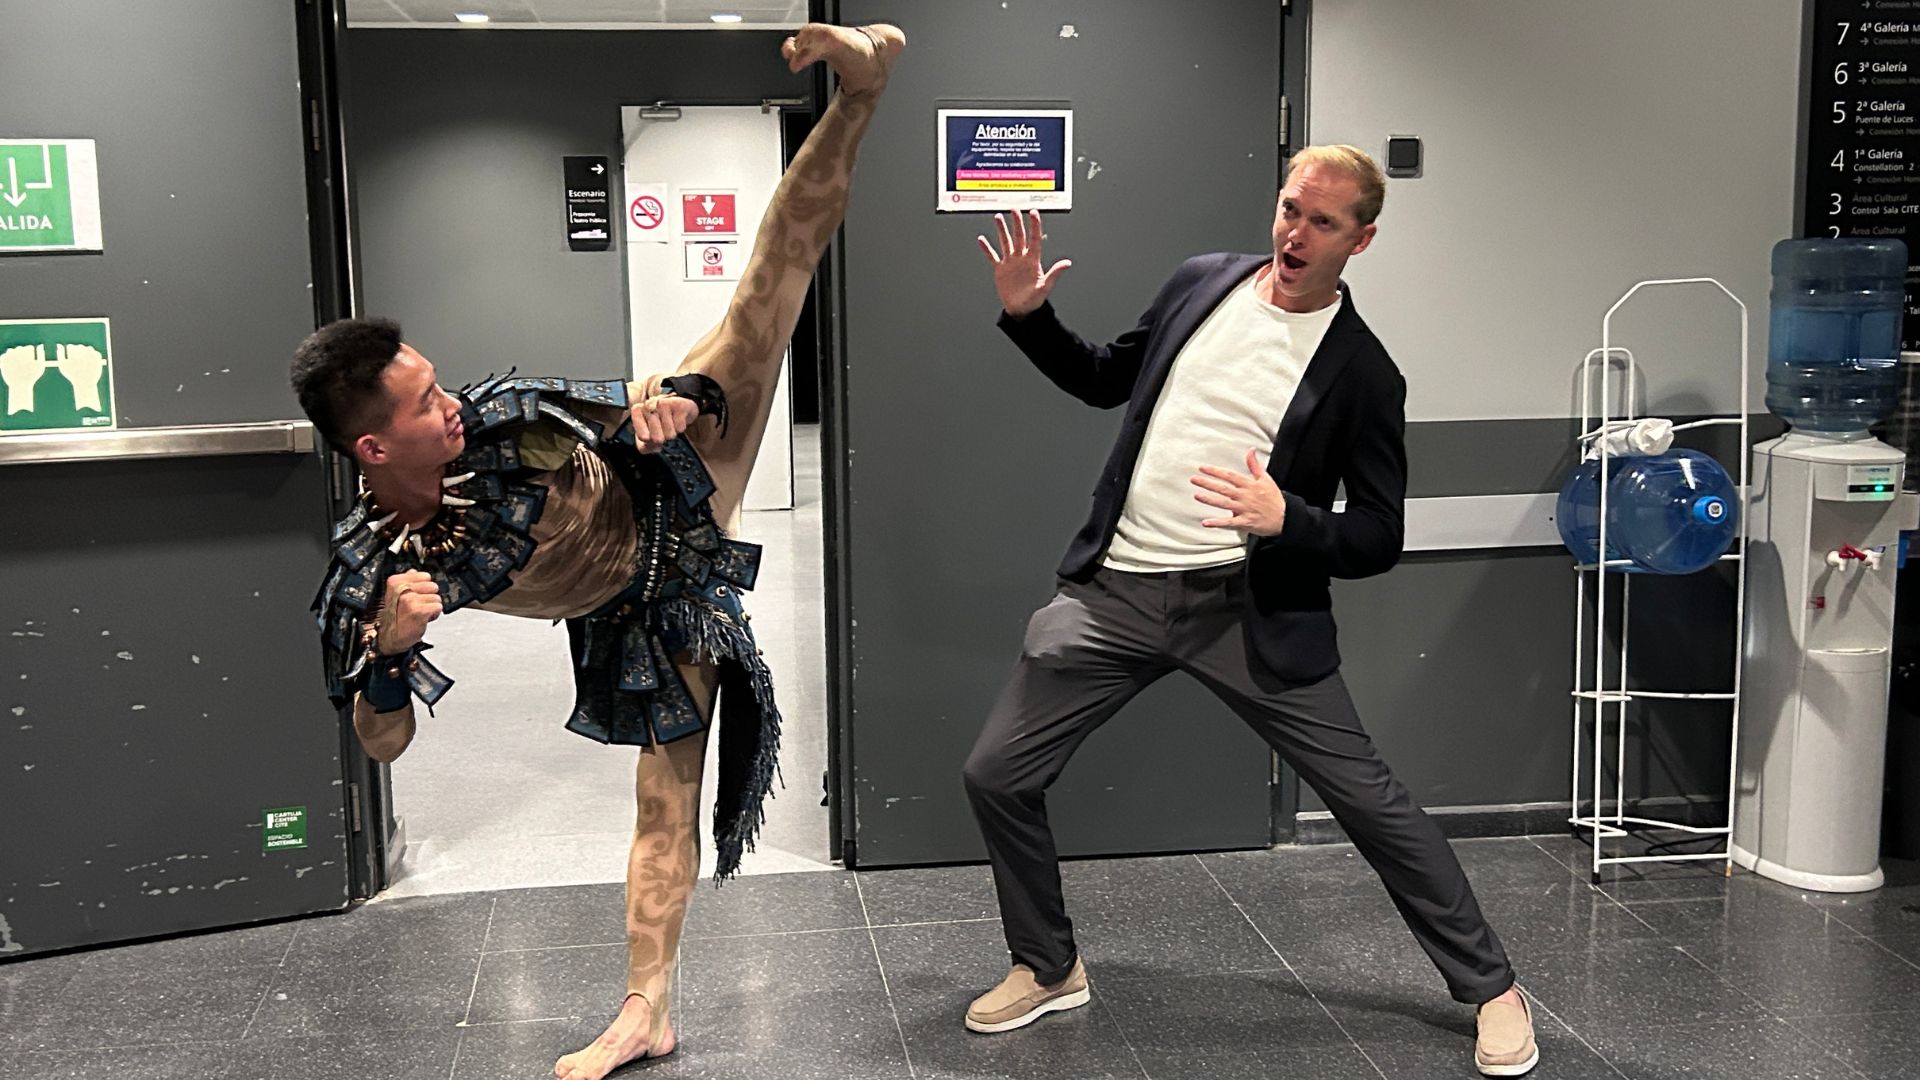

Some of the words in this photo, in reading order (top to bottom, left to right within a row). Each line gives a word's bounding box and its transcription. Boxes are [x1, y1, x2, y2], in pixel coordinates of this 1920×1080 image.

[1860, 22, 1872, 33] 4ª
[1874, 21, 1909, 33] Galería
[1836, 22, 1850, 46] 7
[1857, 61, 1870, 73] 3ª
[1871, 61, 1908, 73] Galería
[1834, 62, 1849, 85] 6
[1856, 101, 1868, 112] 2ª
[1870, 100, 1906, 112] Galería
[1832, 101, 1847, 124] 5
[1855, 115, 1881, 124] Puente
[1882, 115, 1892, 124] de
[1893, 115, 1914, 124] Luces
[975, 123, 1036, 139] Atención
[1854, 149, 1866, 160] 1ª
[1867, 148, 1903, 160] Galería
[1830, 150, 1844, 172] 4
[1853, 163, 1904, 172] Constellation
[1908, 162, 1915, 171] 2
[568, 189, 606, 198] Escenario
[1874, 193, 1908, 203] Cultural
[1828, 192, 1842, 215] 3
[1851, 205, 1880, 215] Control
[1883, 205, 1899, 215] Sala
[1901, 205, 1920, 214] CITE
[696, 216, 725, 226] STAGE
[1872, 225, 1906, 235] Cultural
[267, 833, 293, 841] ESPACIO
[267, 838, 303, 847] SOSTENIBLE
